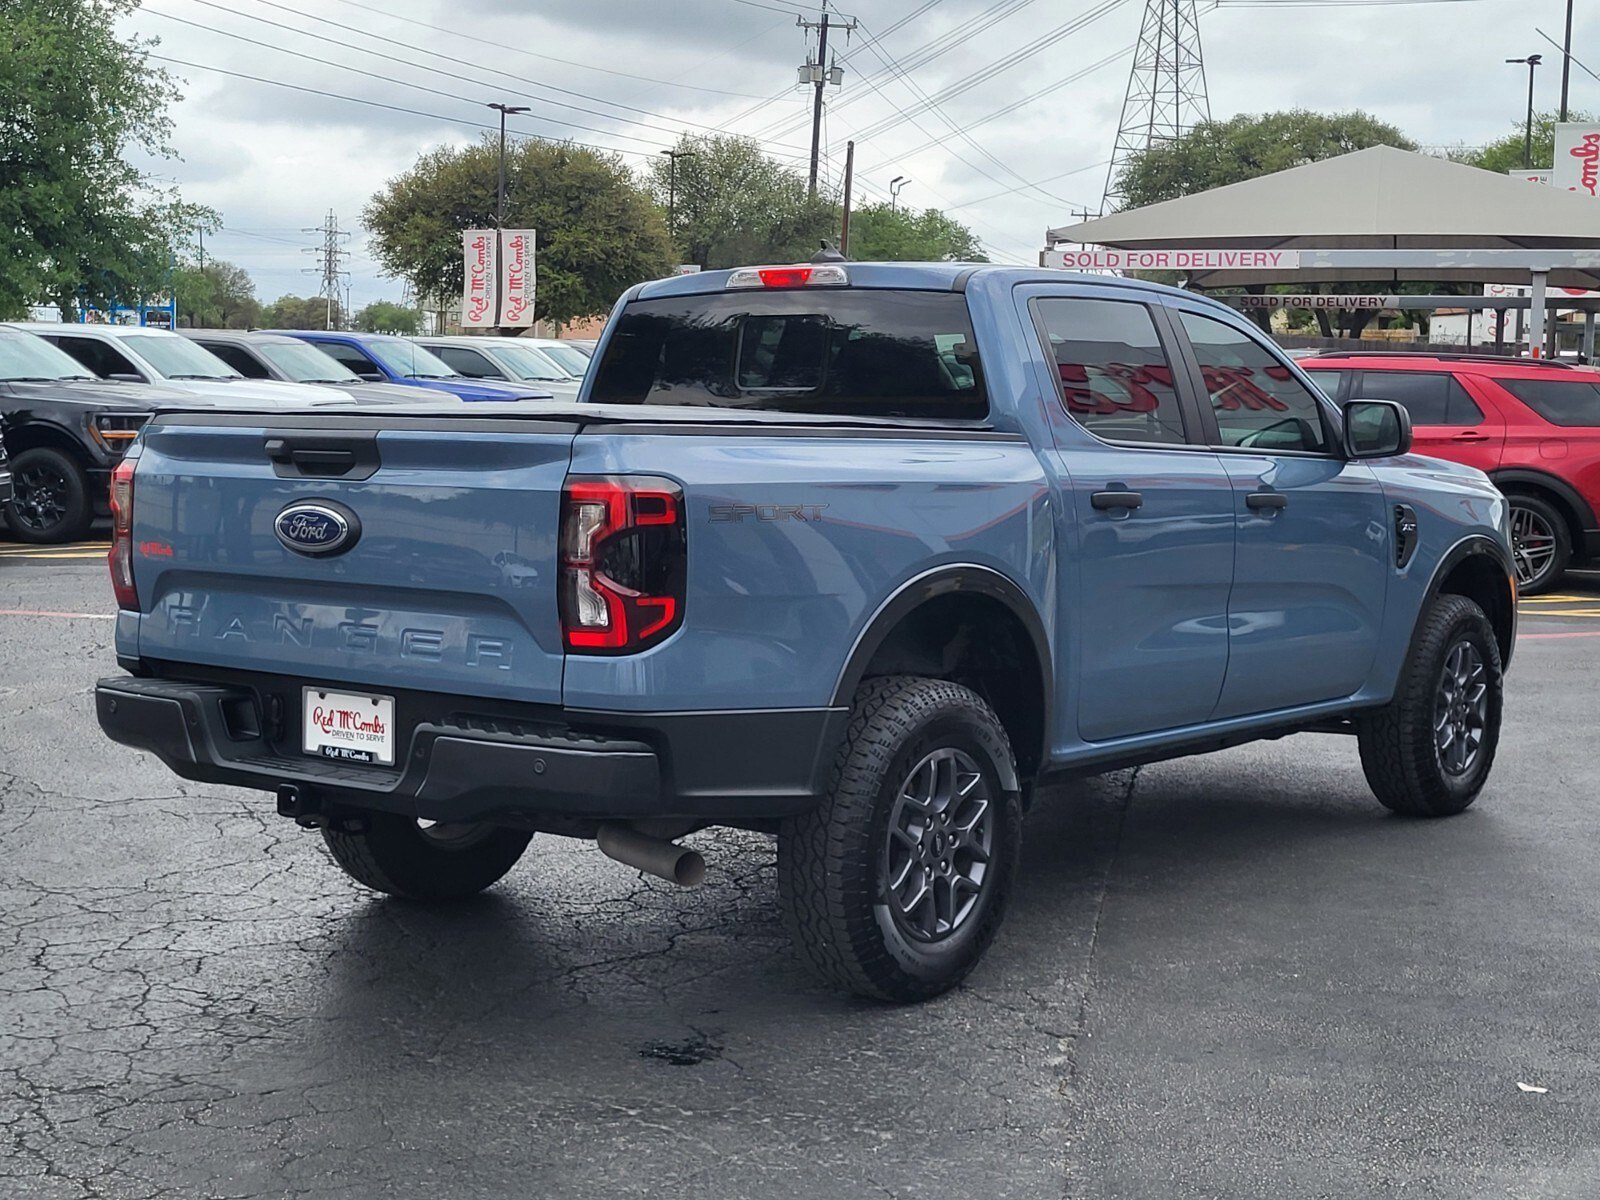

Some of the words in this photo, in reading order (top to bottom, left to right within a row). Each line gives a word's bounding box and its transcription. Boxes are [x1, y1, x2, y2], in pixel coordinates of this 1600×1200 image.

[1569, 133, 1600, 196] ombs
[471, 236, 485, 295] McCombs
[486, 260, 491, 270] TO
[509, 235, 523, 293] McCombs
[524, 259, 530, 270] TO
[1062, 252, 1120, 268] SOLD
[1126, 252, 1169, 268] FOR
[1176, 251, 1282, 268] DELIVERY
[468, 297, 489, 322] Red
[506, 296, 527, 321] Red
[1240, 296, 1279, 308] SOLD
[1282, 296, 1312, 307] FOR
[1316, 296, 1387, 307] DELIVERY
[708, 503, 830, 524] SPORT
[289, 513, 329, 540] Ford
[166, 602, 514, 671] RANGER
[313, 706, 334, 734] Red
[336, 708, 385, 735] McCombs
[331, 729, 355, 740] DRIVEN
[356, 732, 365, 741] TO
[366, 733, 385, 743] SERVE
[325, 746, 340, 759] Red
